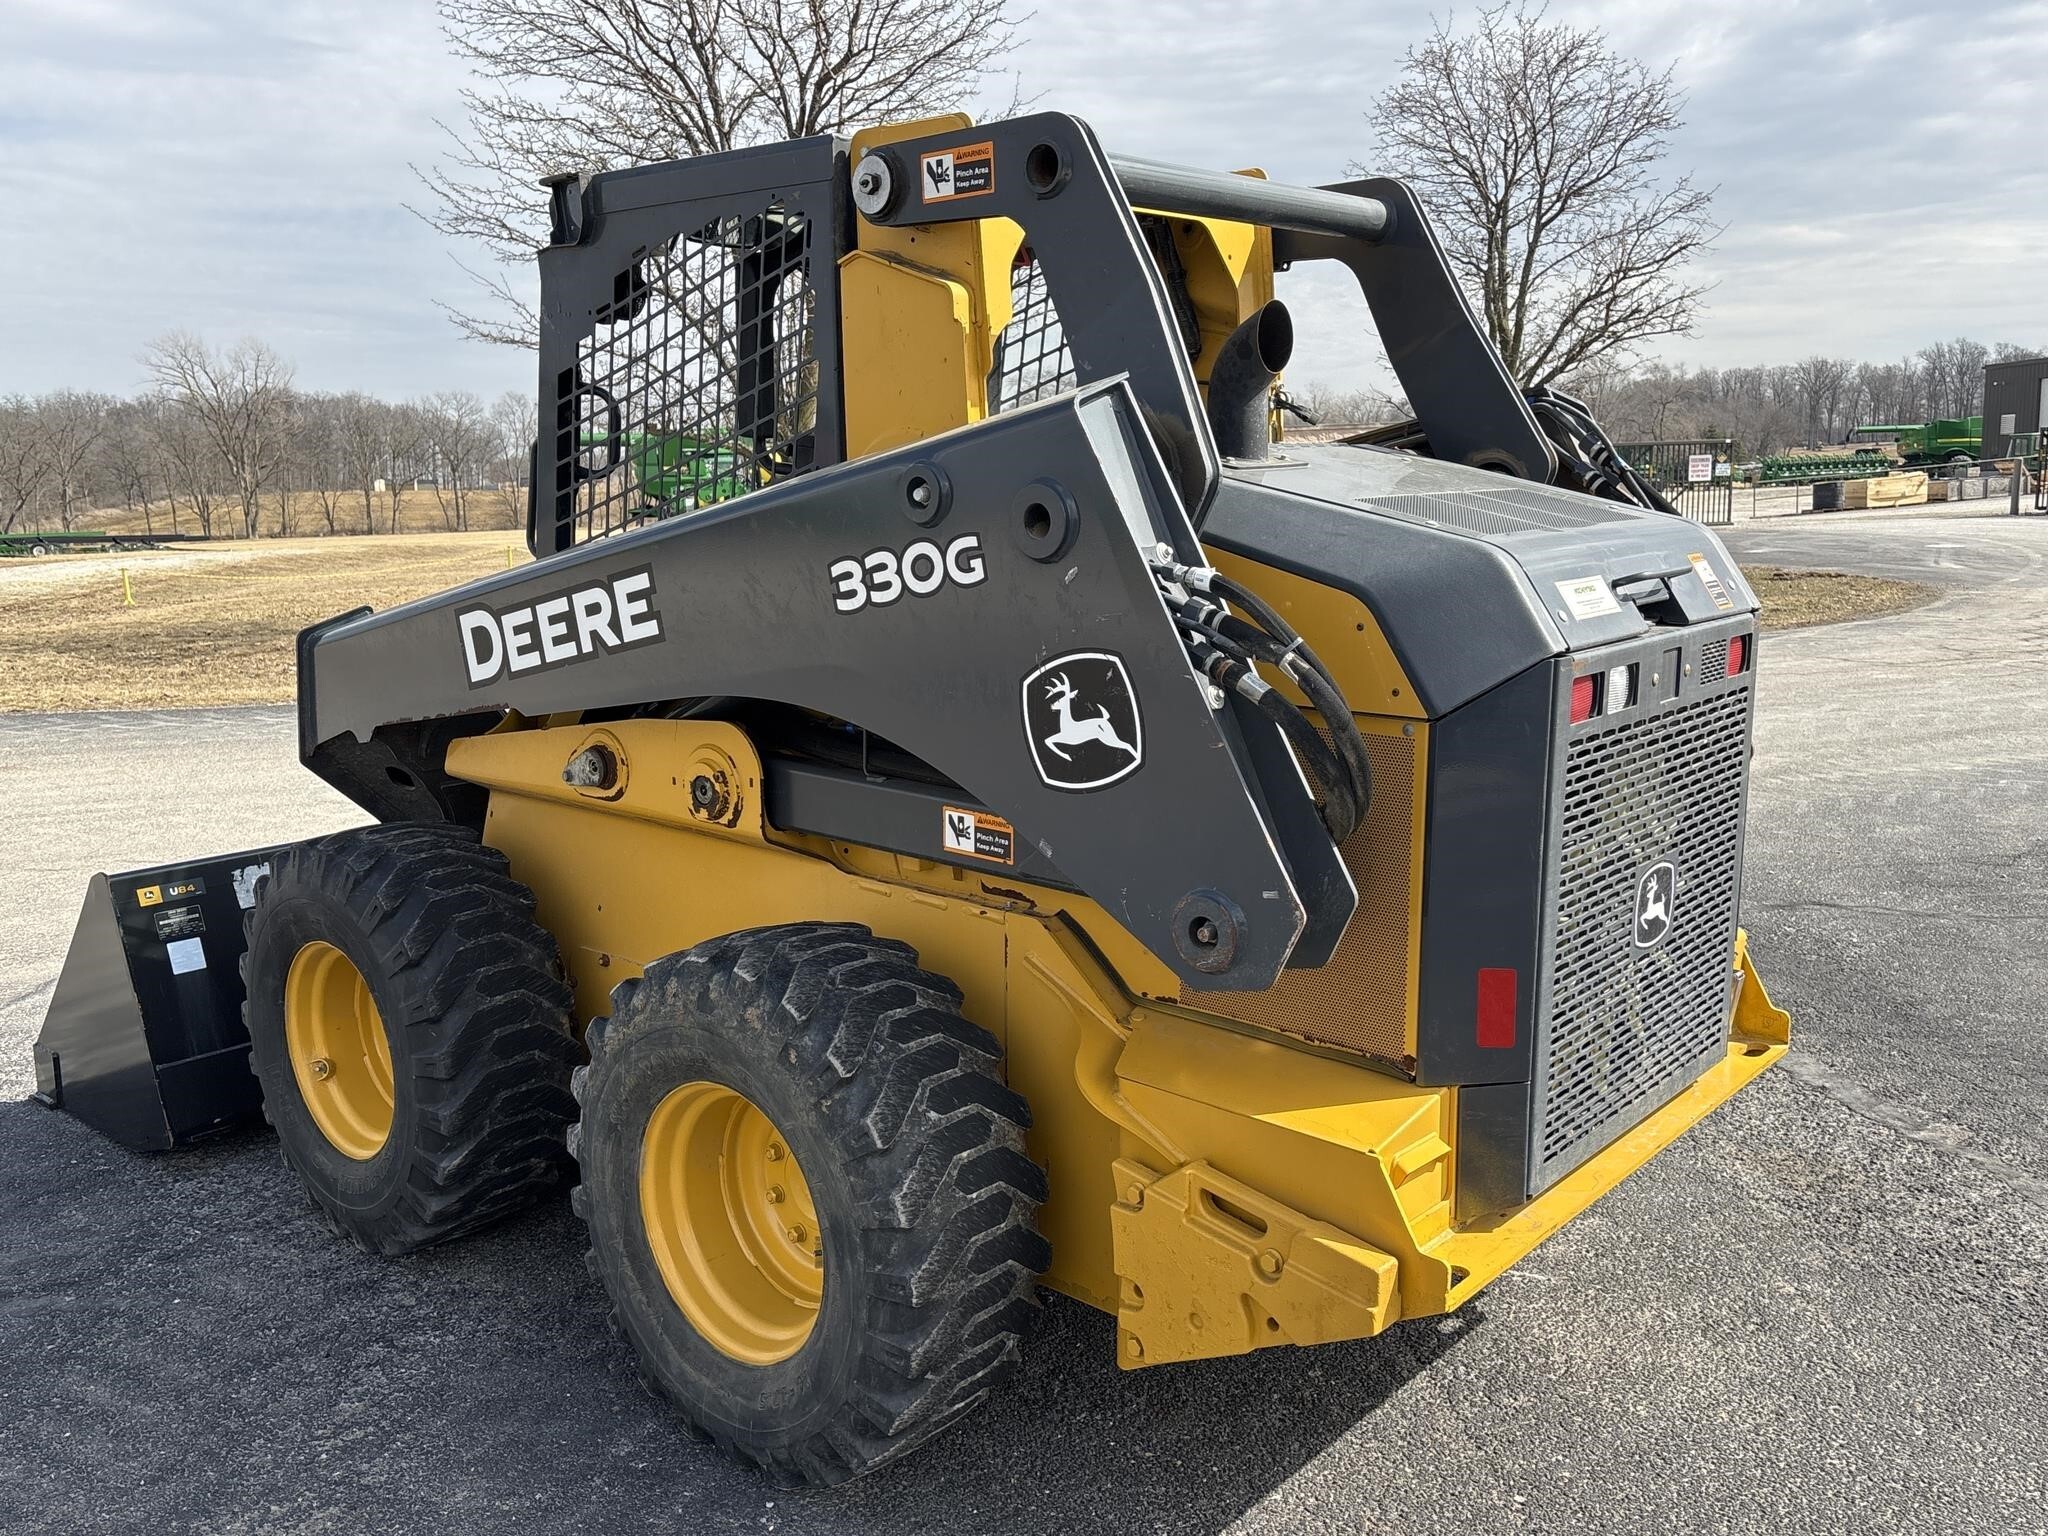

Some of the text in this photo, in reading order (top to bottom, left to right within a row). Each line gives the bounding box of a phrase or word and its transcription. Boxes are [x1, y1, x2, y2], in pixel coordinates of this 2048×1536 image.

[962, 147, 990, 158] WARNING
[956, 167, 989, 178] Pinch Area
[830, 535, 985, 612] 330G
[459, 572, 660, 682] DEERE
[976, 833, 1009, 845] Pinch Area
[976, 842, 1004, 854] Keep Away
